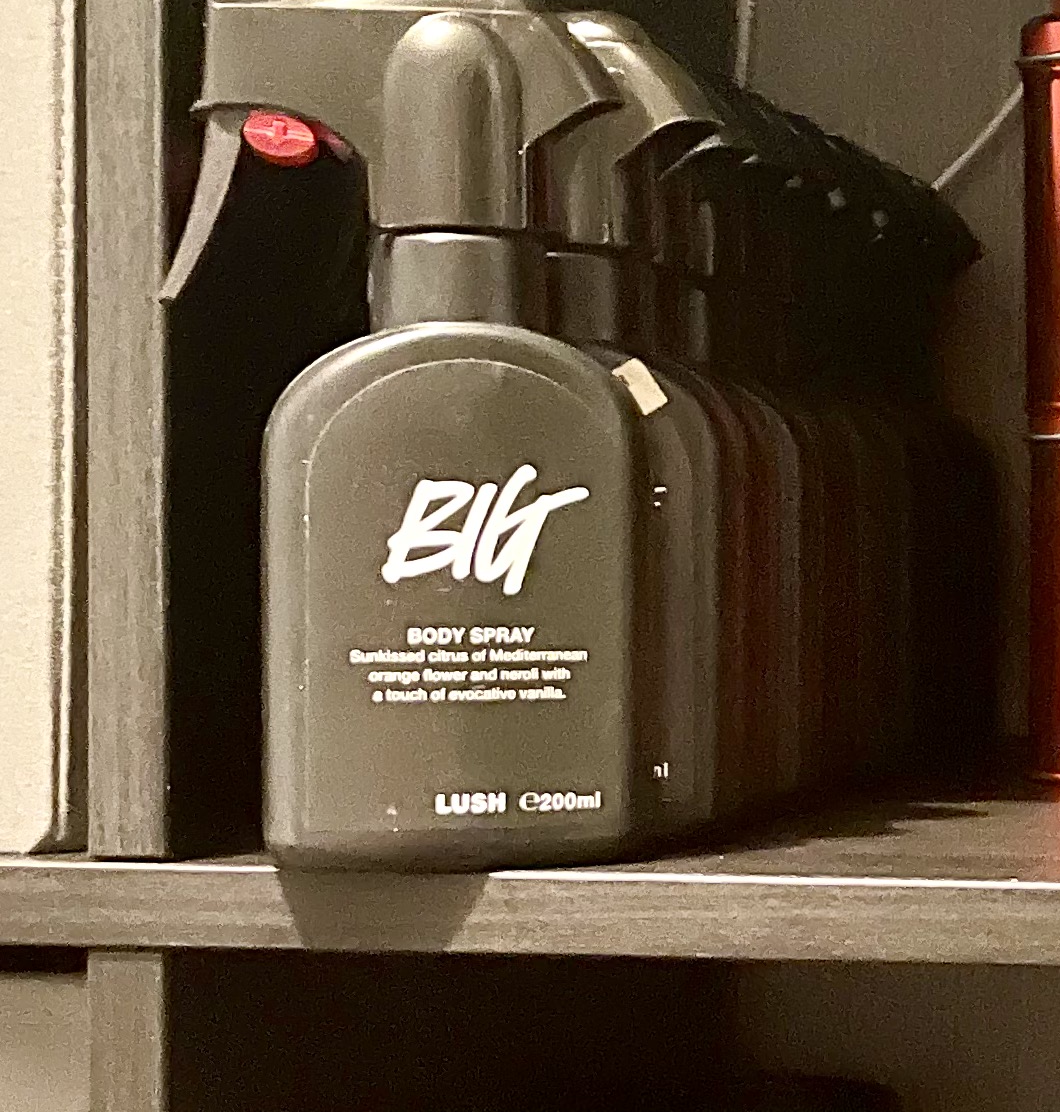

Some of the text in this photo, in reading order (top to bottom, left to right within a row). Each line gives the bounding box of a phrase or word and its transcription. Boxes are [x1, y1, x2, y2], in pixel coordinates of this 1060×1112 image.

[381, 464, 590, 595] BIG
[407, 626, 535, 645] BODY SPRAY
[350, 648, 588, 664] Sunkissed citrus of Mediterranean
[368, 669, 420, 685] orange
[422, 668, 468, 682] flower
[470, 667, 498, 681] and
[541, 666, 571, 680] with
[372, 690, 384, 701] a
[385, 687, 428, 701] touch
[429, 687, 447, 700] of
[434, 792, 507, 815] LUSH
